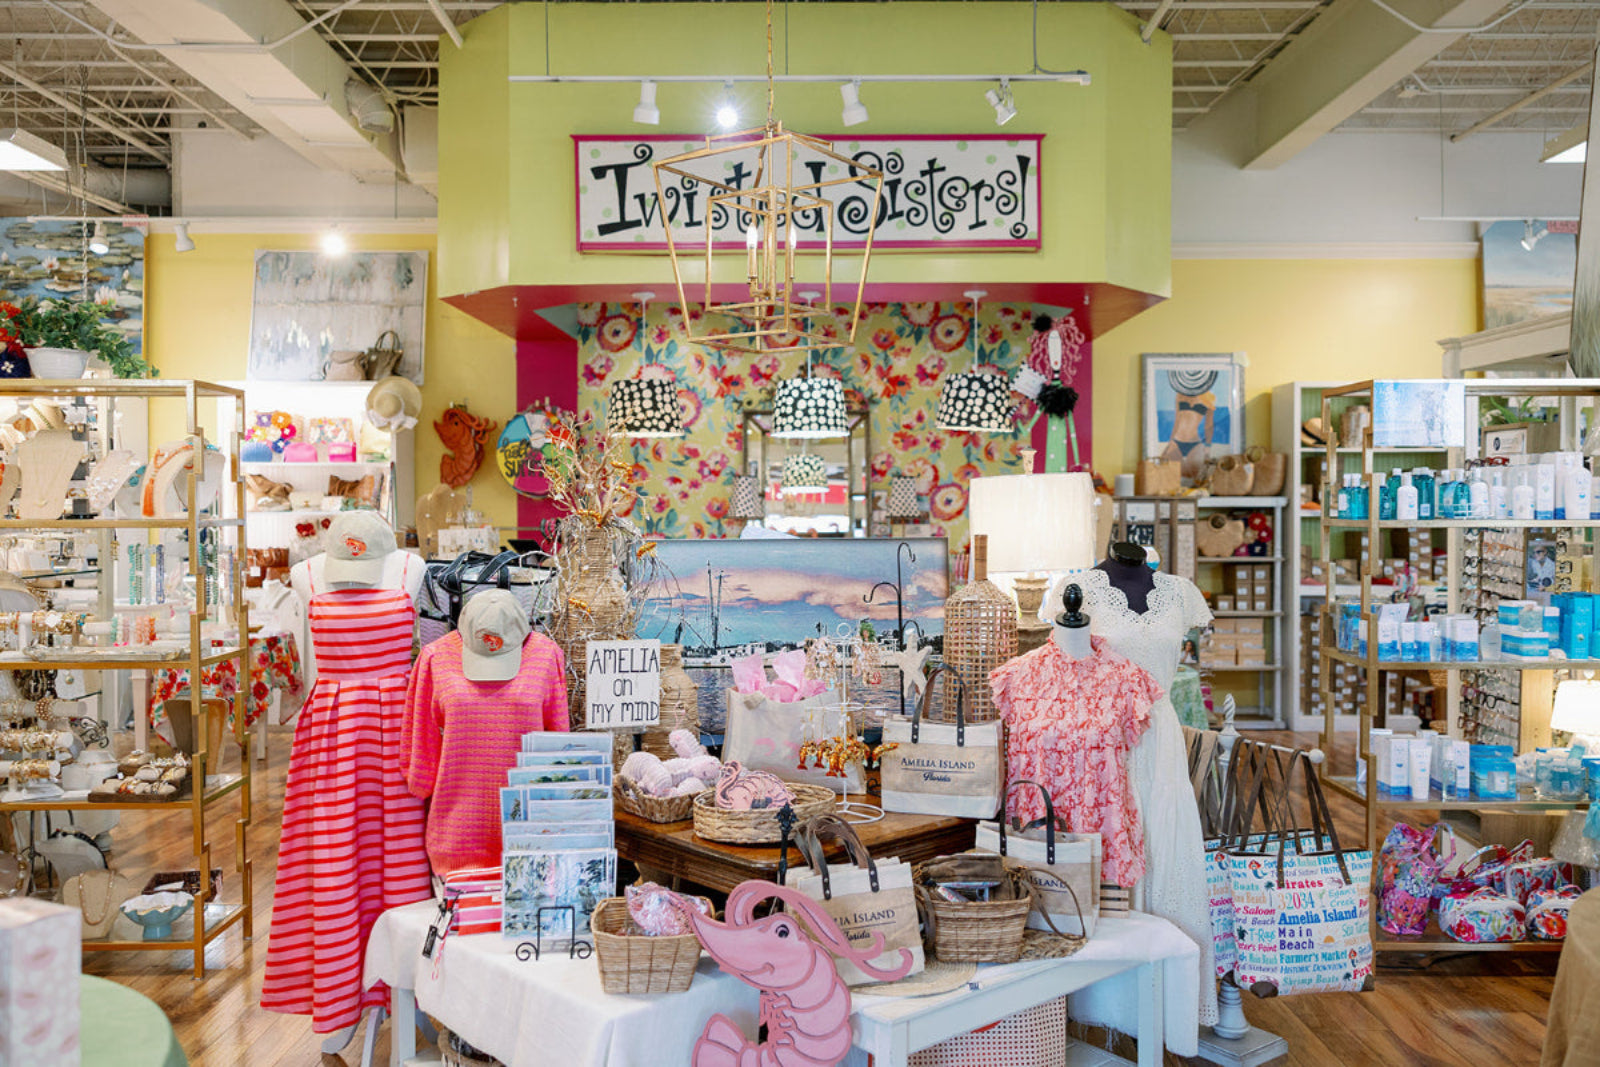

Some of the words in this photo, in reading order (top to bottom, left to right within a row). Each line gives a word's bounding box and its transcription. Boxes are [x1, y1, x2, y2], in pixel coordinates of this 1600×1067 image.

[837, 151, 1031, 239] Sisters!
[589, 647, 659, 674] AMELIA
[613, 678, 633, 697] on
[592, 703, 615, 724] MY
[620, 701, 660, 722] MIND
[900, 757, 936, 768] AMELIA
[939, 759, 976, 769] ISLAND
[1278, 891, 1315, 910] 32034
[853, 908, 895, 924] ISLAND
[1278, 912, 1321, 925] Amelia
[1322, 906, 1358, 923] Island
[1278, 926, 1313, 938] Main
[1279, 938, 1315, 950] Beach
[1280, 952, 1319, 964] Farmer's
